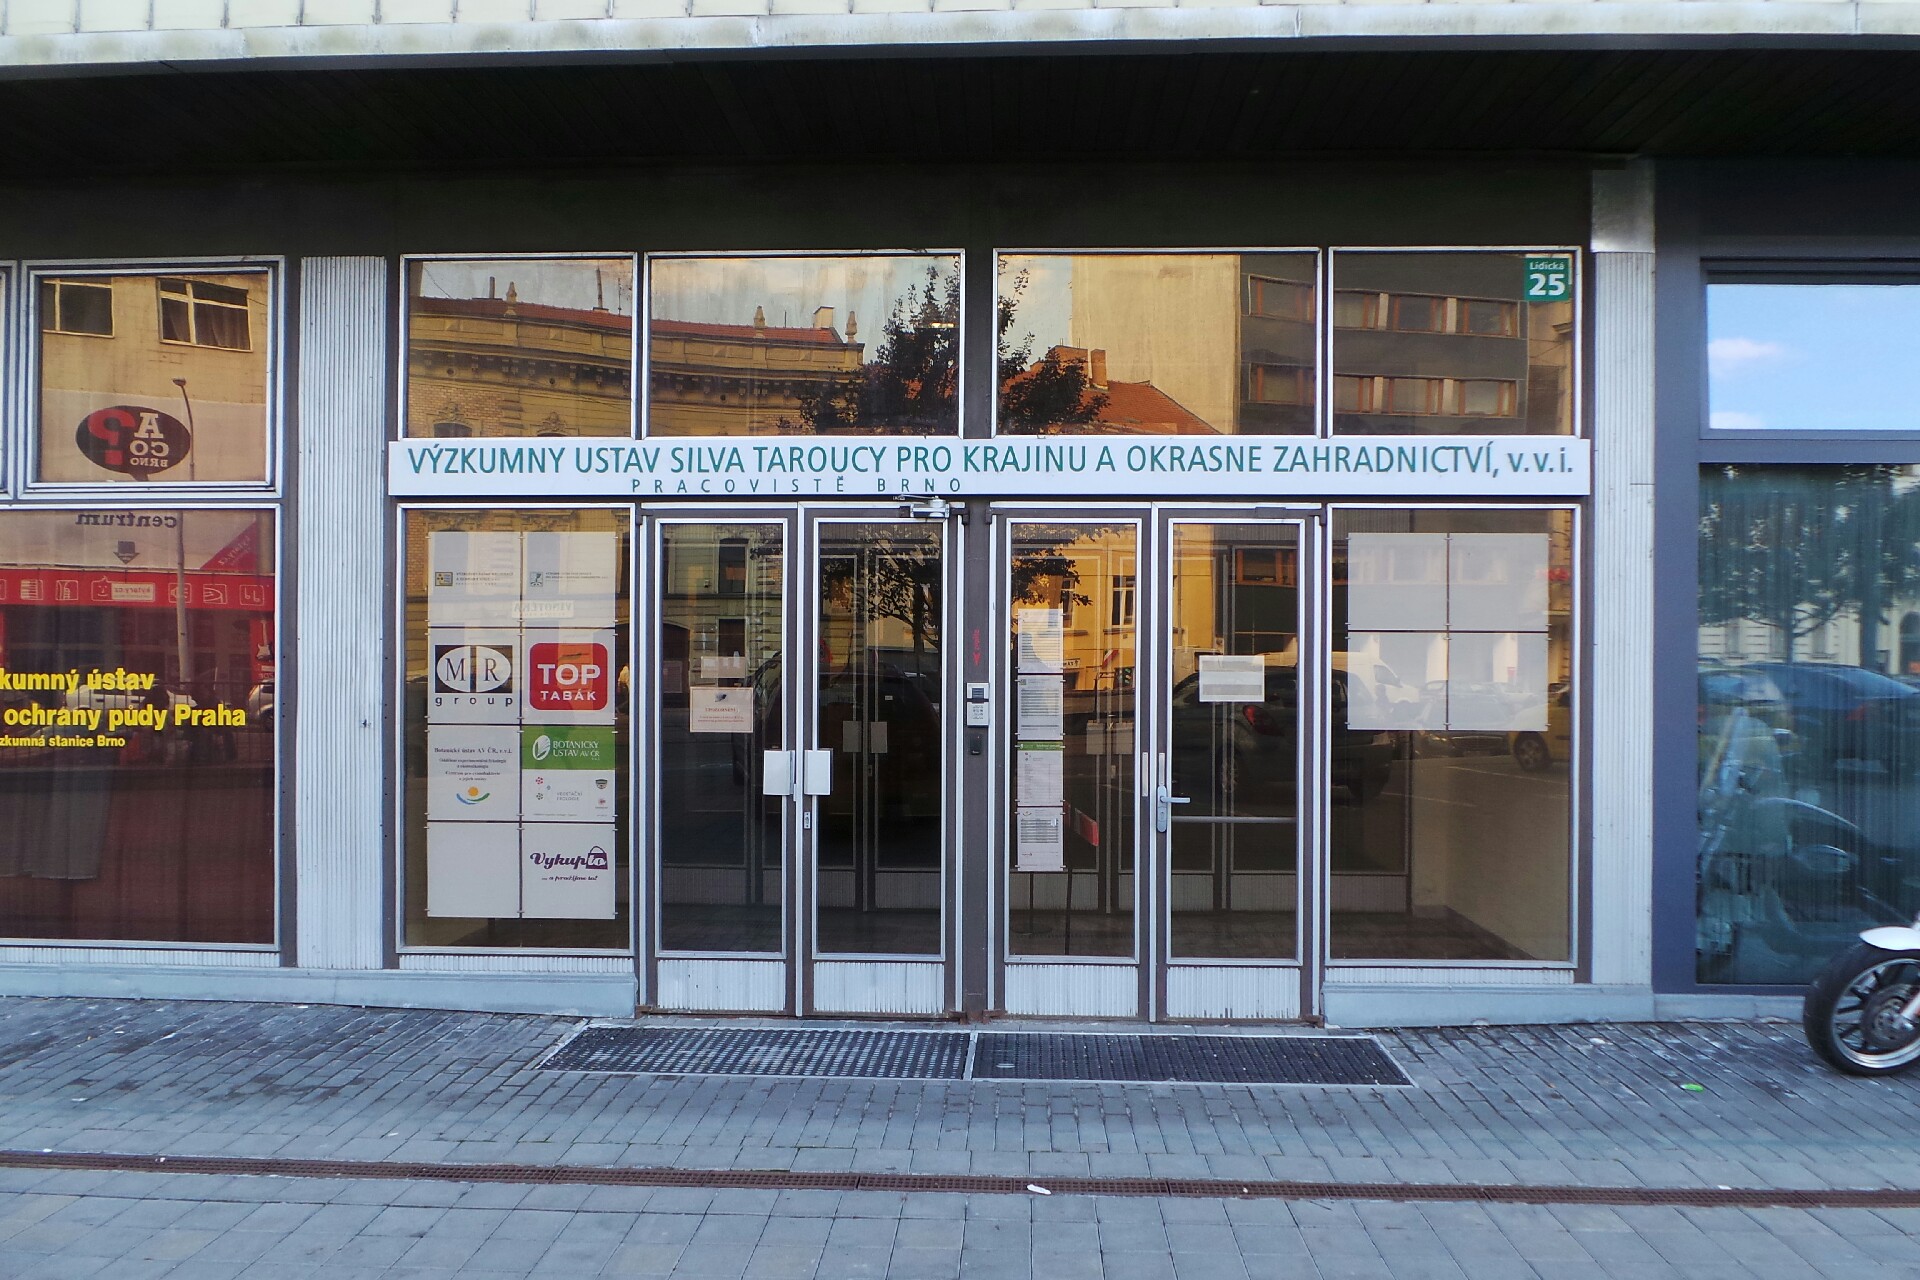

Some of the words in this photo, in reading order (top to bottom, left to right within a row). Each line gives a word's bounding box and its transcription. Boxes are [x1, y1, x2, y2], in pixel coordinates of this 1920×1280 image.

[1529, 261, 1565, 270] Lidická
[1529, 273, 1565, 296] 25
[670, 446, 745, 473] SILVA
[753, 445, 886, 473] TAROUCY
[897, 445, 952, 473] PRO
[963, 445, 1086, 473] KRAJINU
[1095, 445, 1116, 472] A
[1273, 441, 1499, 478] ZAHRADNICTVÍ,
[878, 478, 961, 493] BRNO
[0, 667, 79, 697] kumný
[87, 667, 155, 691] ústav
[537, 663, 601, 686] TOP
[435, 696, 513, 707] group
[540, 689, 597, 701] TABÁK
[4, 703, 103, 730] ochrany
[109, 703, 168, 731] půdy
[174, 703, 246, 727] Praha
[0, 734, 45, 747] zkumná
[48, 735, 94, 747] stanice
[96, 735, 126, 747] Brno
